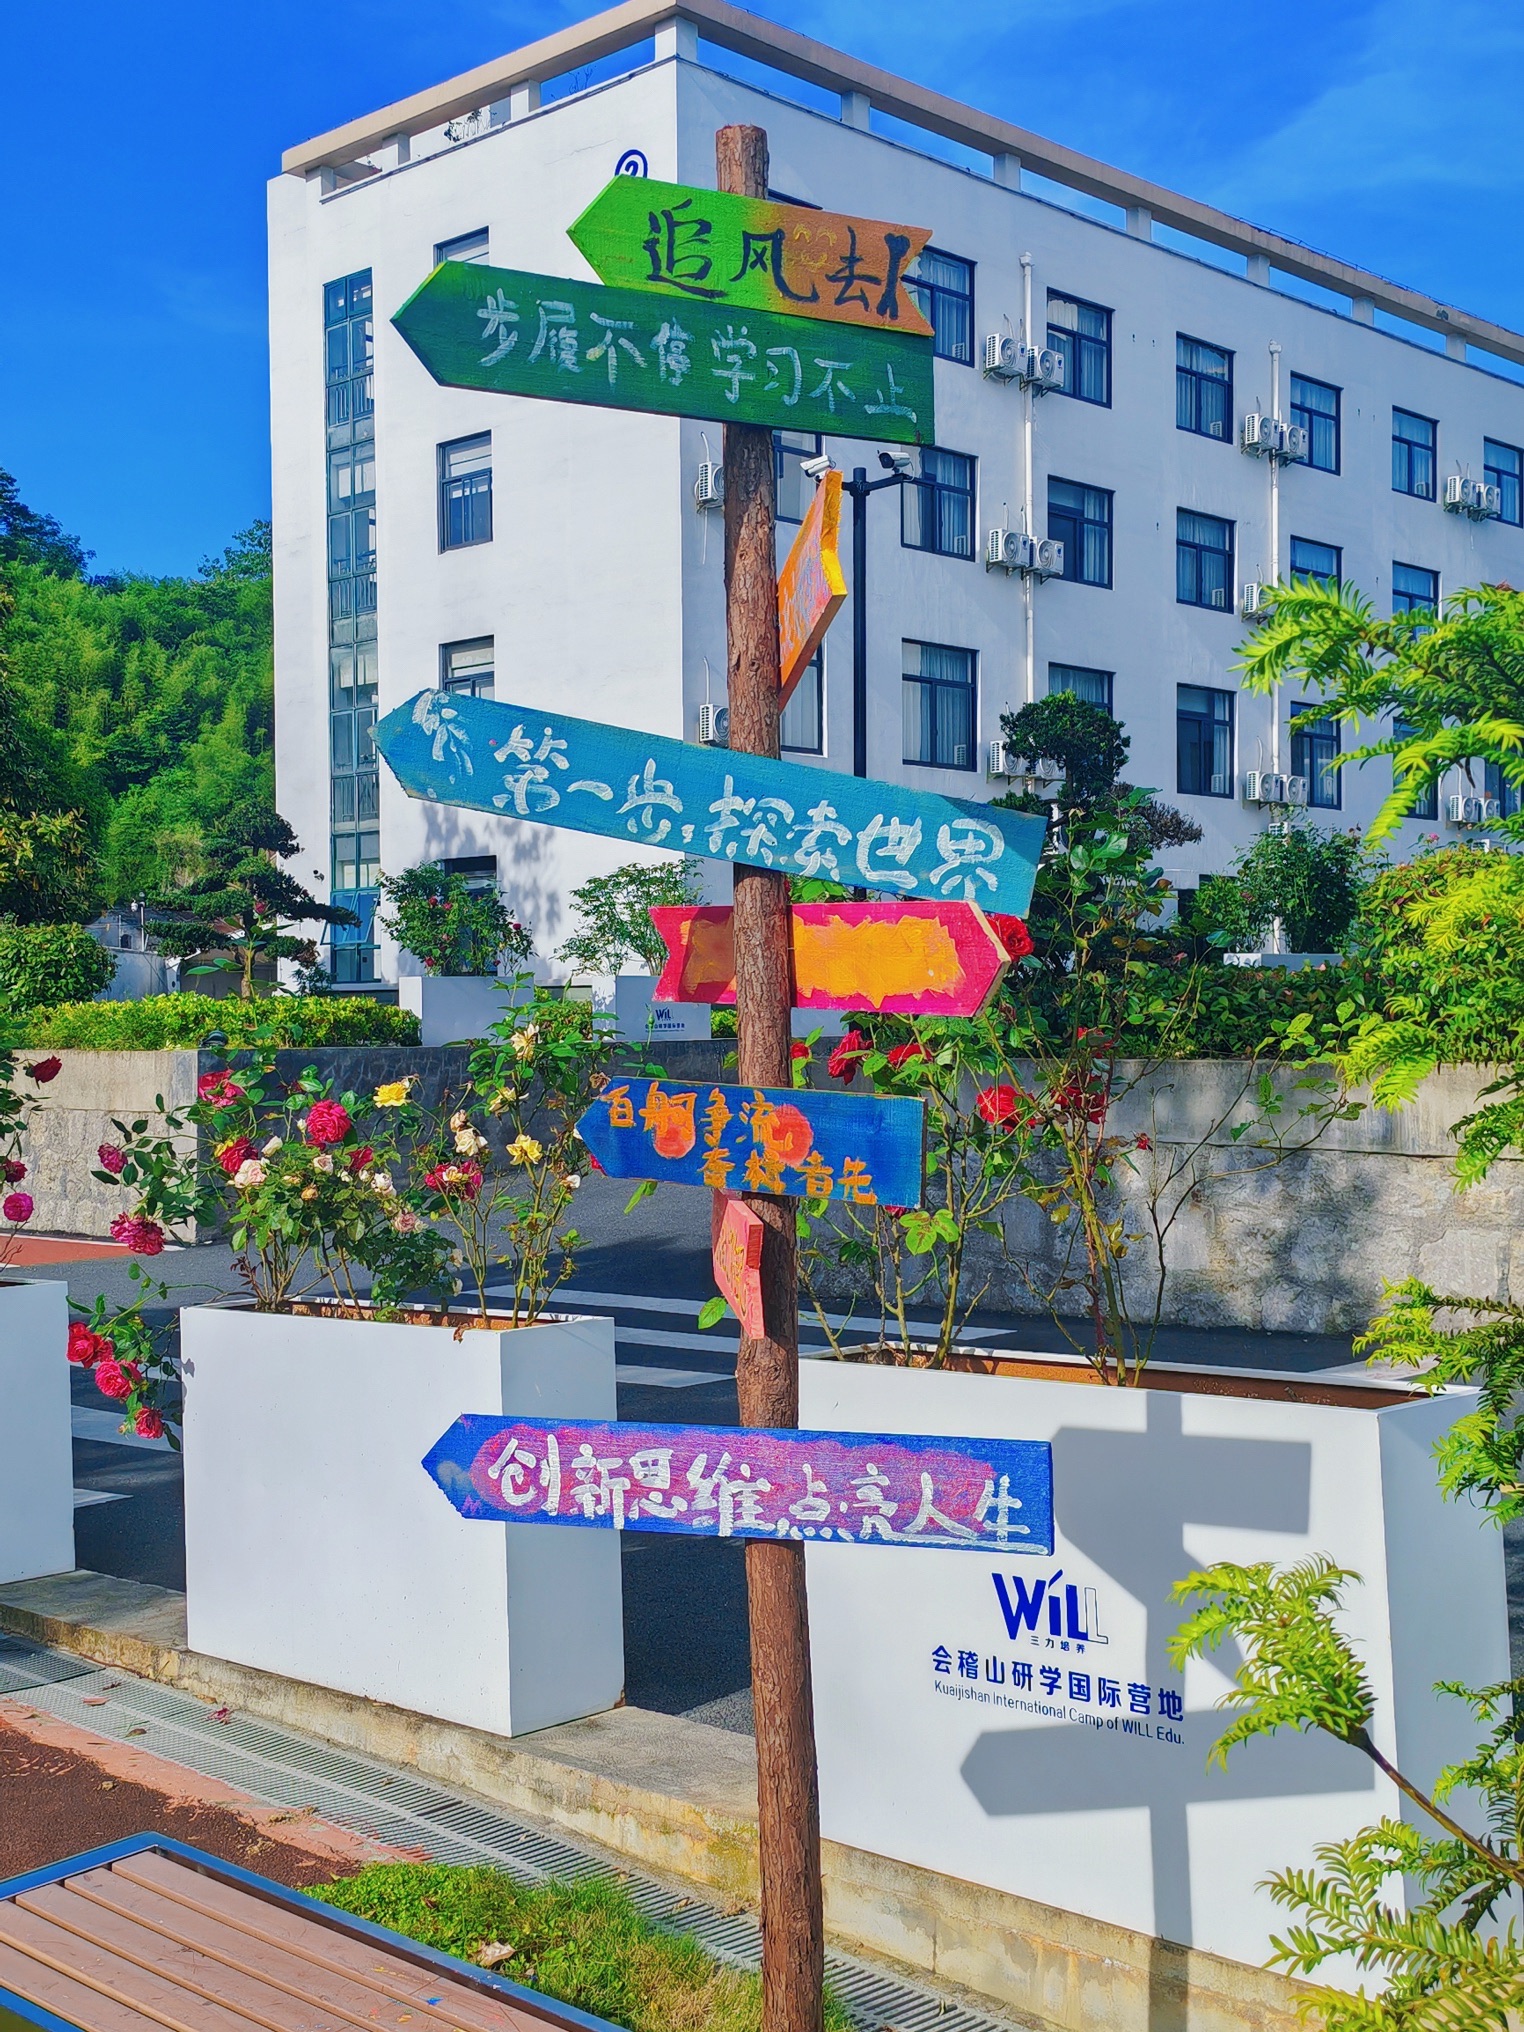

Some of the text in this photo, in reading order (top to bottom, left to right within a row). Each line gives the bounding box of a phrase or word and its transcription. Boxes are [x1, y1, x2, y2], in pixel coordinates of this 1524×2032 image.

[1030, 1635, 1086, 1654] 三力培养
[931, 1645, 1184, 1722] 会稽山研学国际营地
[934, 1680, 1185, 1745] Kuaijishan International Camp of WILL Edu.
